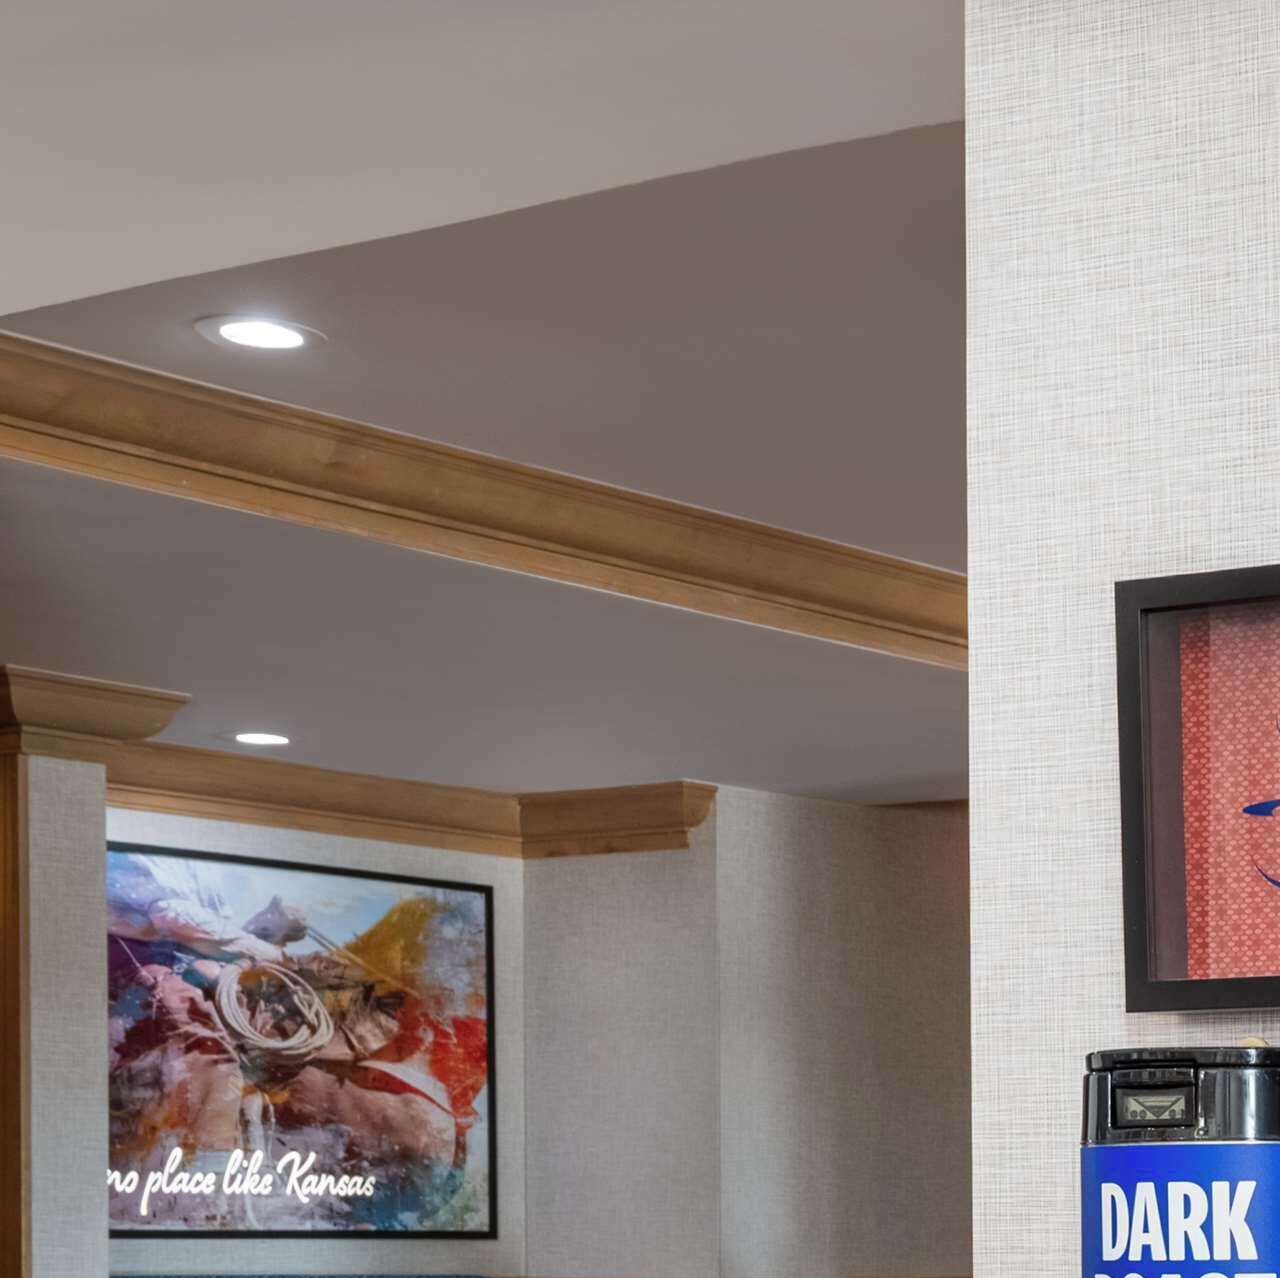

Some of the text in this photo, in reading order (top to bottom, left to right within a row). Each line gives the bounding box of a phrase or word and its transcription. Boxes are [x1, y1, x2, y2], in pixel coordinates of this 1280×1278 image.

[139, 1147, 217, 1216] place
[223, 1149, 273, 1195] like
[276, 1151, 376, 1203] Kansas
[1101, 1180, 1259, 1262] DARK
